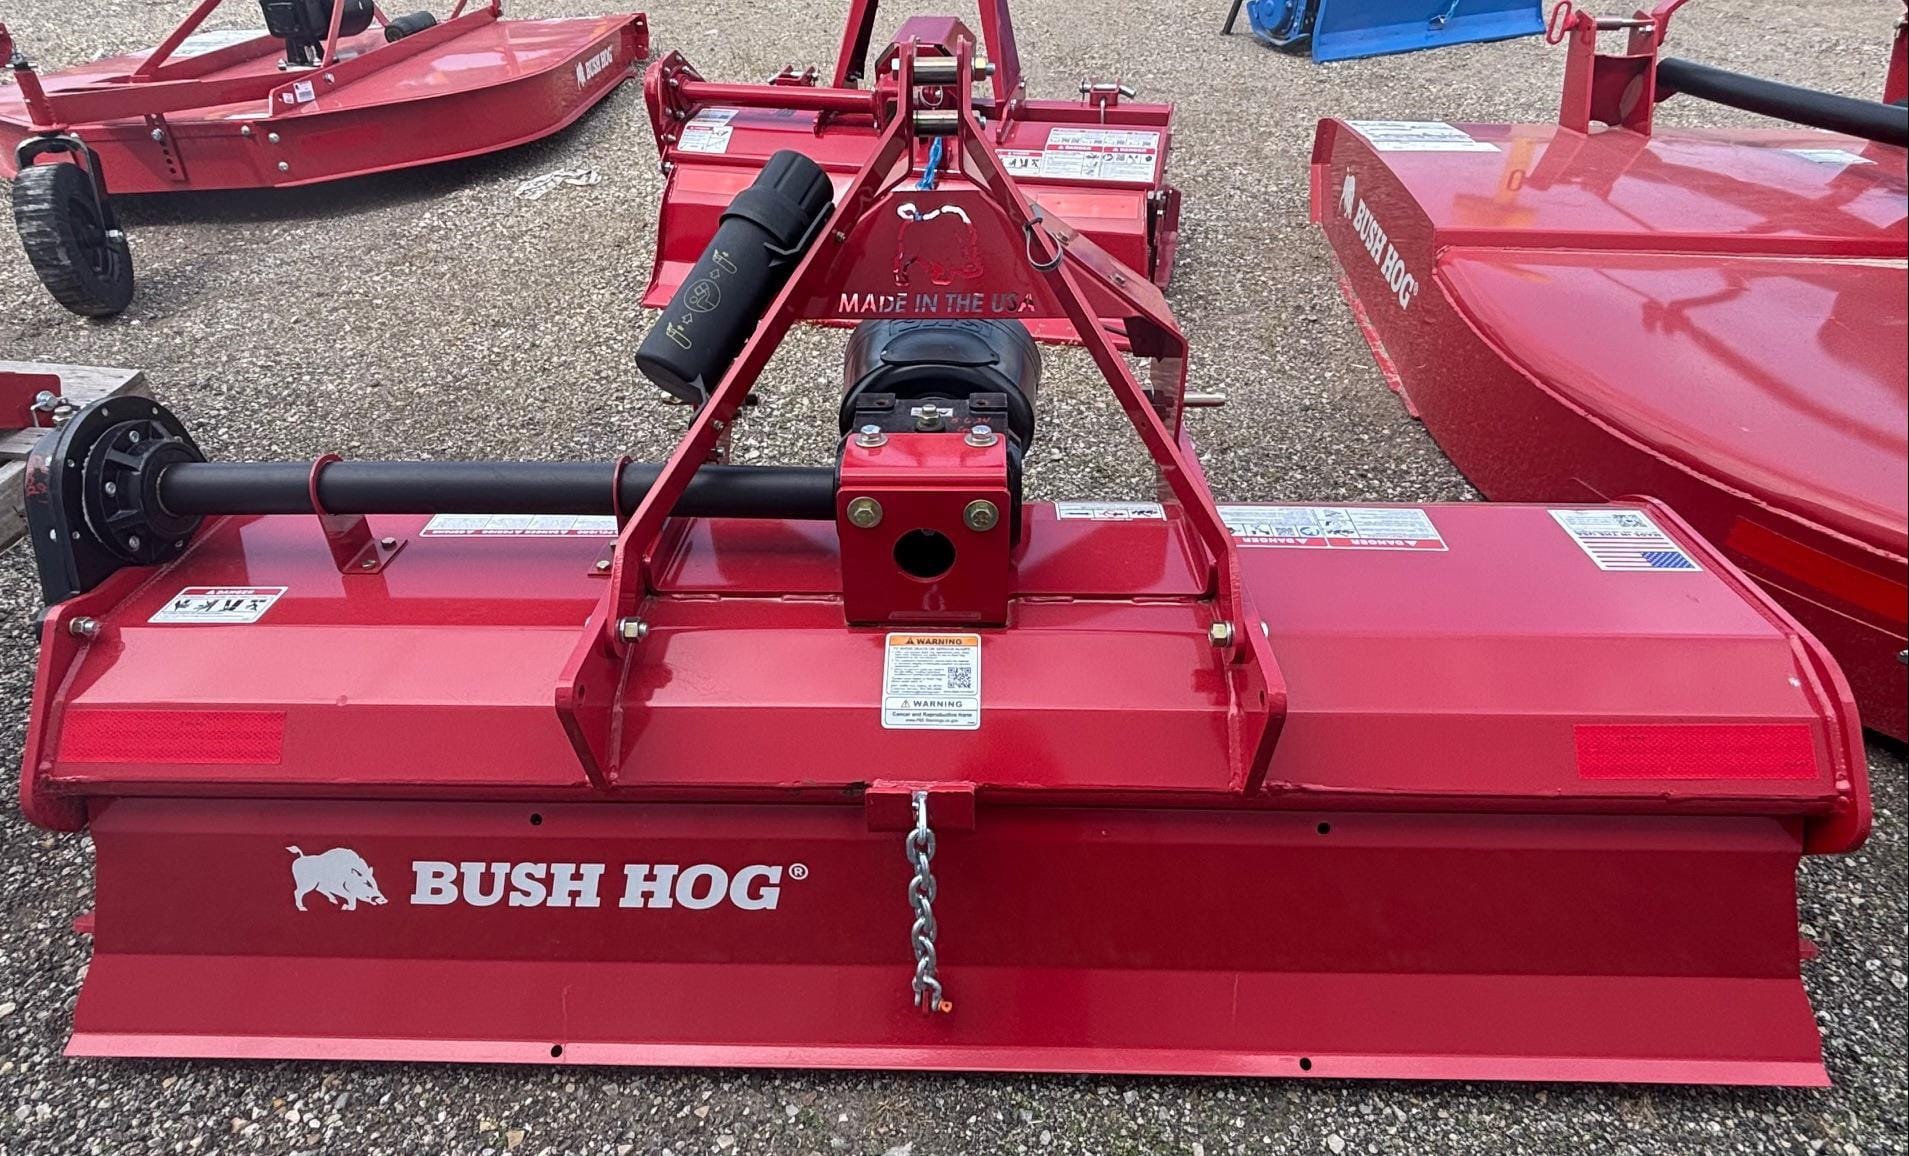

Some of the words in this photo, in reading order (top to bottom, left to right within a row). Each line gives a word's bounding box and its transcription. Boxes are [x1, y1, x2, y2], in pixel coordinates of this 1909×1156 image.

[1353, 197, 1388, 265] BUSH
[838, 292, 908, 313] MADE
[914, 292, 937, 313] IN
[945, 292, 985, 313] THE
[991, 292, 1036, 313] USA
[1243, 537, 1295, 545] DANGER
[913, 700, 963, 708] WARNING
[410, 860, 605, 908] BUSH
